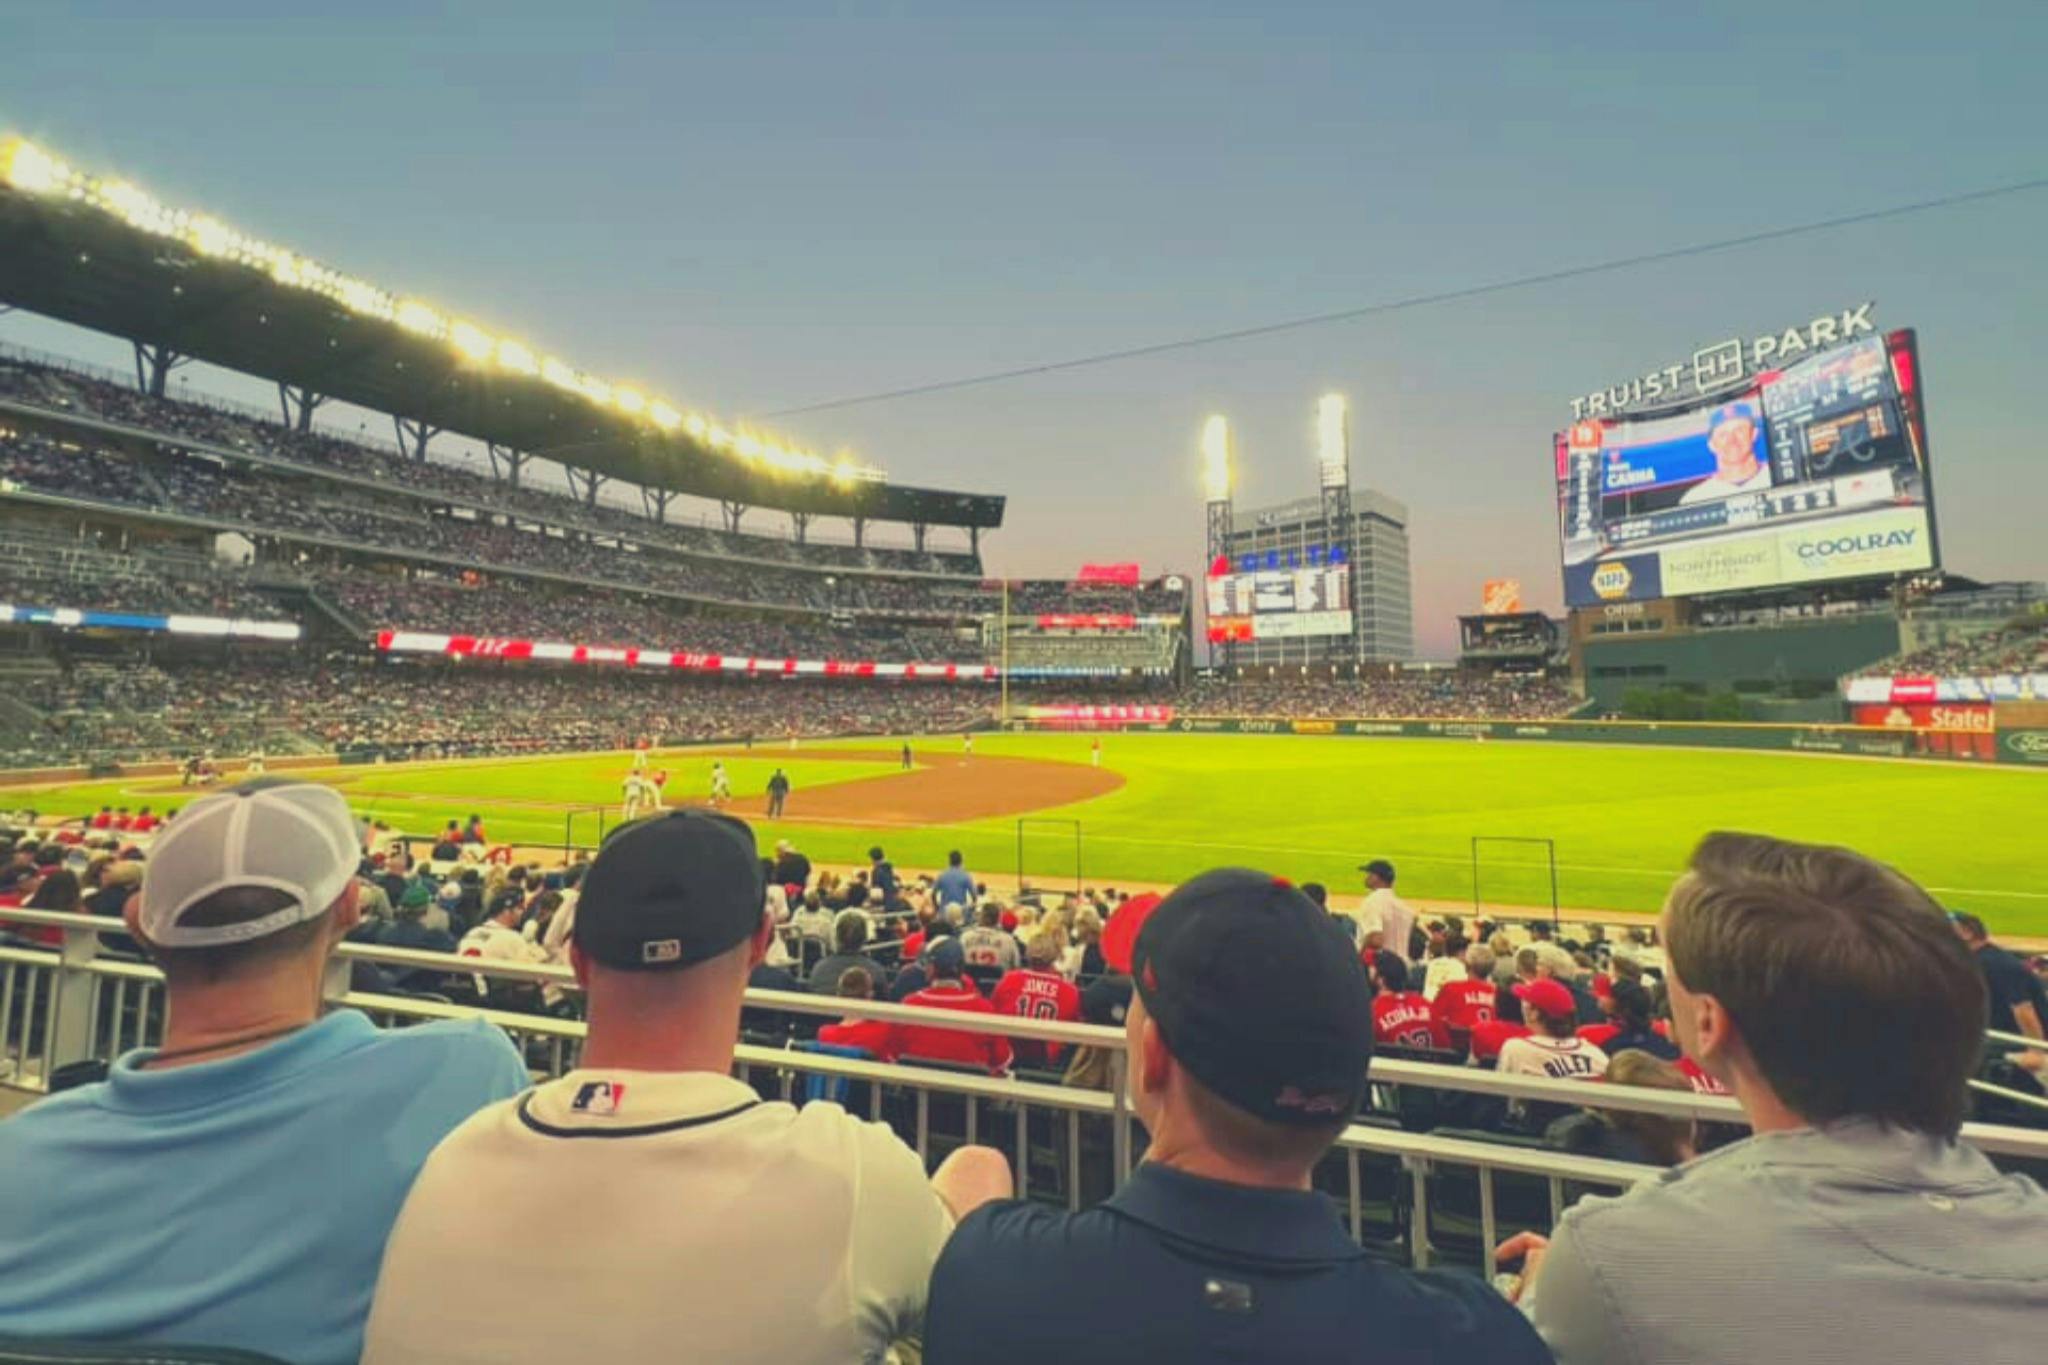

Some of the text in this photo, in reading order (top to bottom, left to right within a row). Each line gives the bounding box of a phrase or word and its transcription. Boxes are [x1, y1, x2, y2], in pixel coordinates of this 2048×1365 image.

[1570, 302, 1873, 419] TRUIST PARK
[1798, 529, 1914, 558] COOLRAY
[1931, 708, 1984, 730] State
[1021, 978, 1058, 997] JONES
[1544, 1054, 1592, 1079] RILEY
